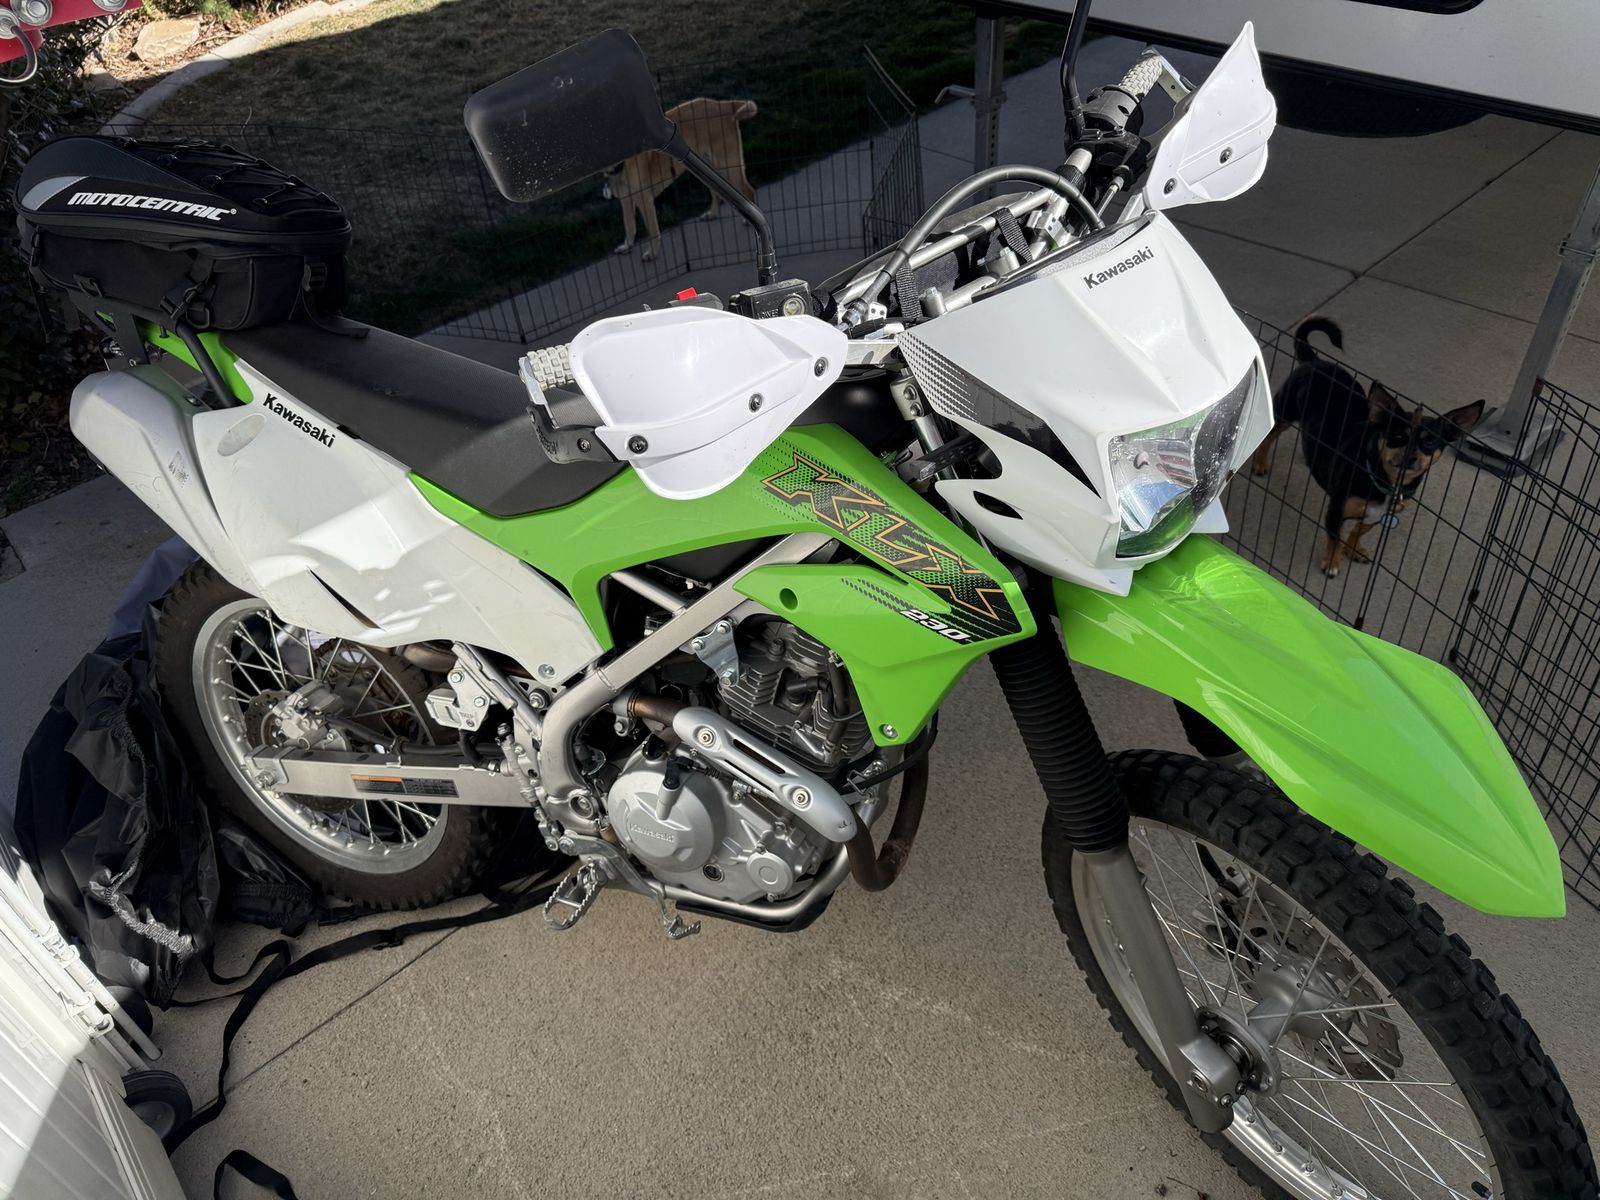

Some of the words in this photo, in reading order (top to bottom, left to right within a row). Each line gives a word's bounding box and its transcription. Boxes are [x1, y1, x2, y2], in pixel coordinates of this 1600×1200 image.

[67, 192, 231, 221] MOTOCENTRIC
[1083, 246, 1154, 290] Kawasaki
[263, 392, 336, 448] Kawasaki
[761, 451, 1004, 620] KLX
[900, 609, 972, 640] 230
